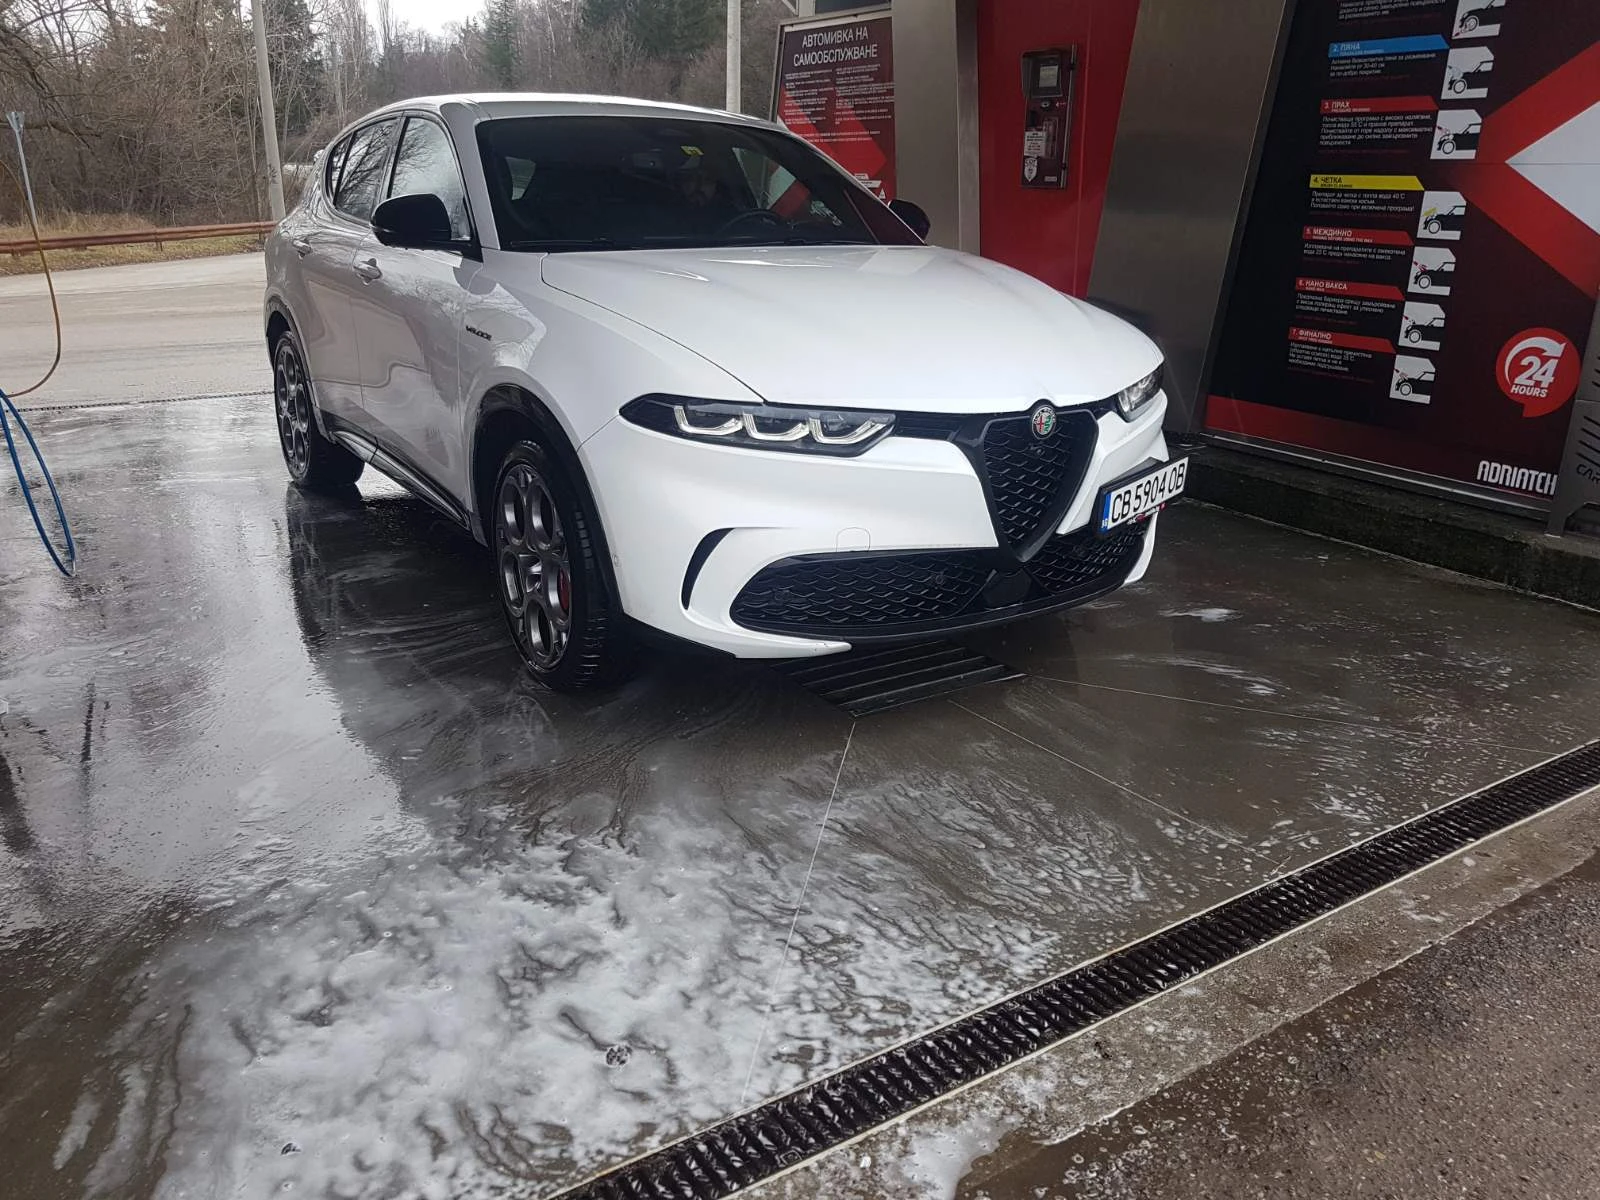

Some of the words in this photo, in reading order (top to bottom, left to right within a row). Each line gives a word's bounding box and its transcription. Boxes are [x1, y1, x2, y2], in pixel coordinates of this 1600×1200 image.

[802, 28, 856, 48] АВТОМИВКА
[856, 26, 869, 41] НА
[1340, 42, 1360, 51] ПЯНА
[793, 44, 877, 67] САМООБСЛУЖВАНЕ
[1321, 176, 1342, 184] ЧЕТКА
[1312, 228, 1352, 237] МЕЖДИННО
[1305, 280, 1324, 288] НАНО
[1325, 282, 1347, 290] ВАКСА
[1299, 330, 1332, 339] ФИНАЛНО
[1514, 355, 1559, 388] 24
[1510, 384, 1548, 398] HOURS
